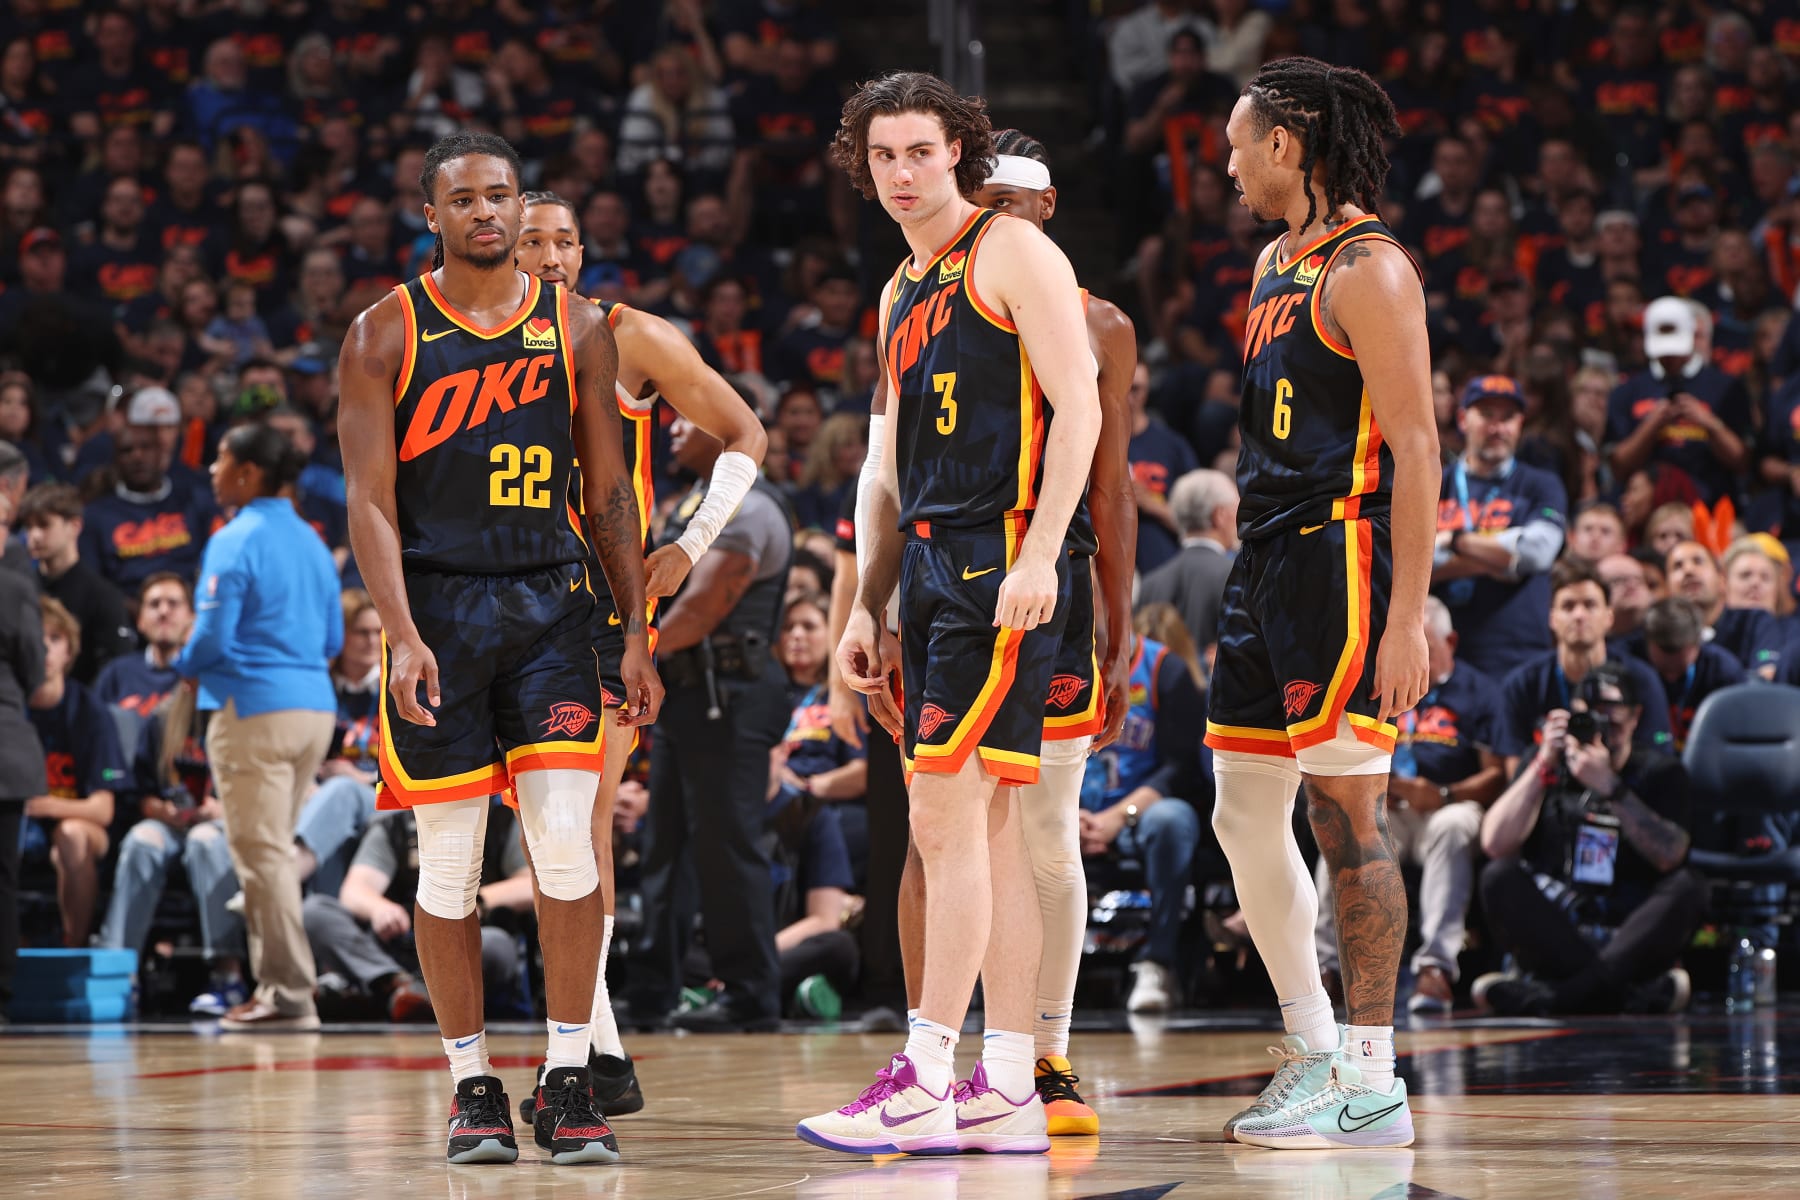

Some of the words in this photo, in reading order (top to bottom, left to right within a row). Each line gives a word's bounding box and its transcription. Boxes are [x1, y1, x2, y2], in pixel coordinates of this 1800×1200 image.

[525, 336, 555, 348] Love's
[888, 281, 960, 400] OKC
[399, 354, 555, 462] OKC
[932, 371, 958, 436] 3
[1272, 377, 1294, 440] 6
[489, 443, 552, 508] 22
[551, 710, 583, 728] OKC
